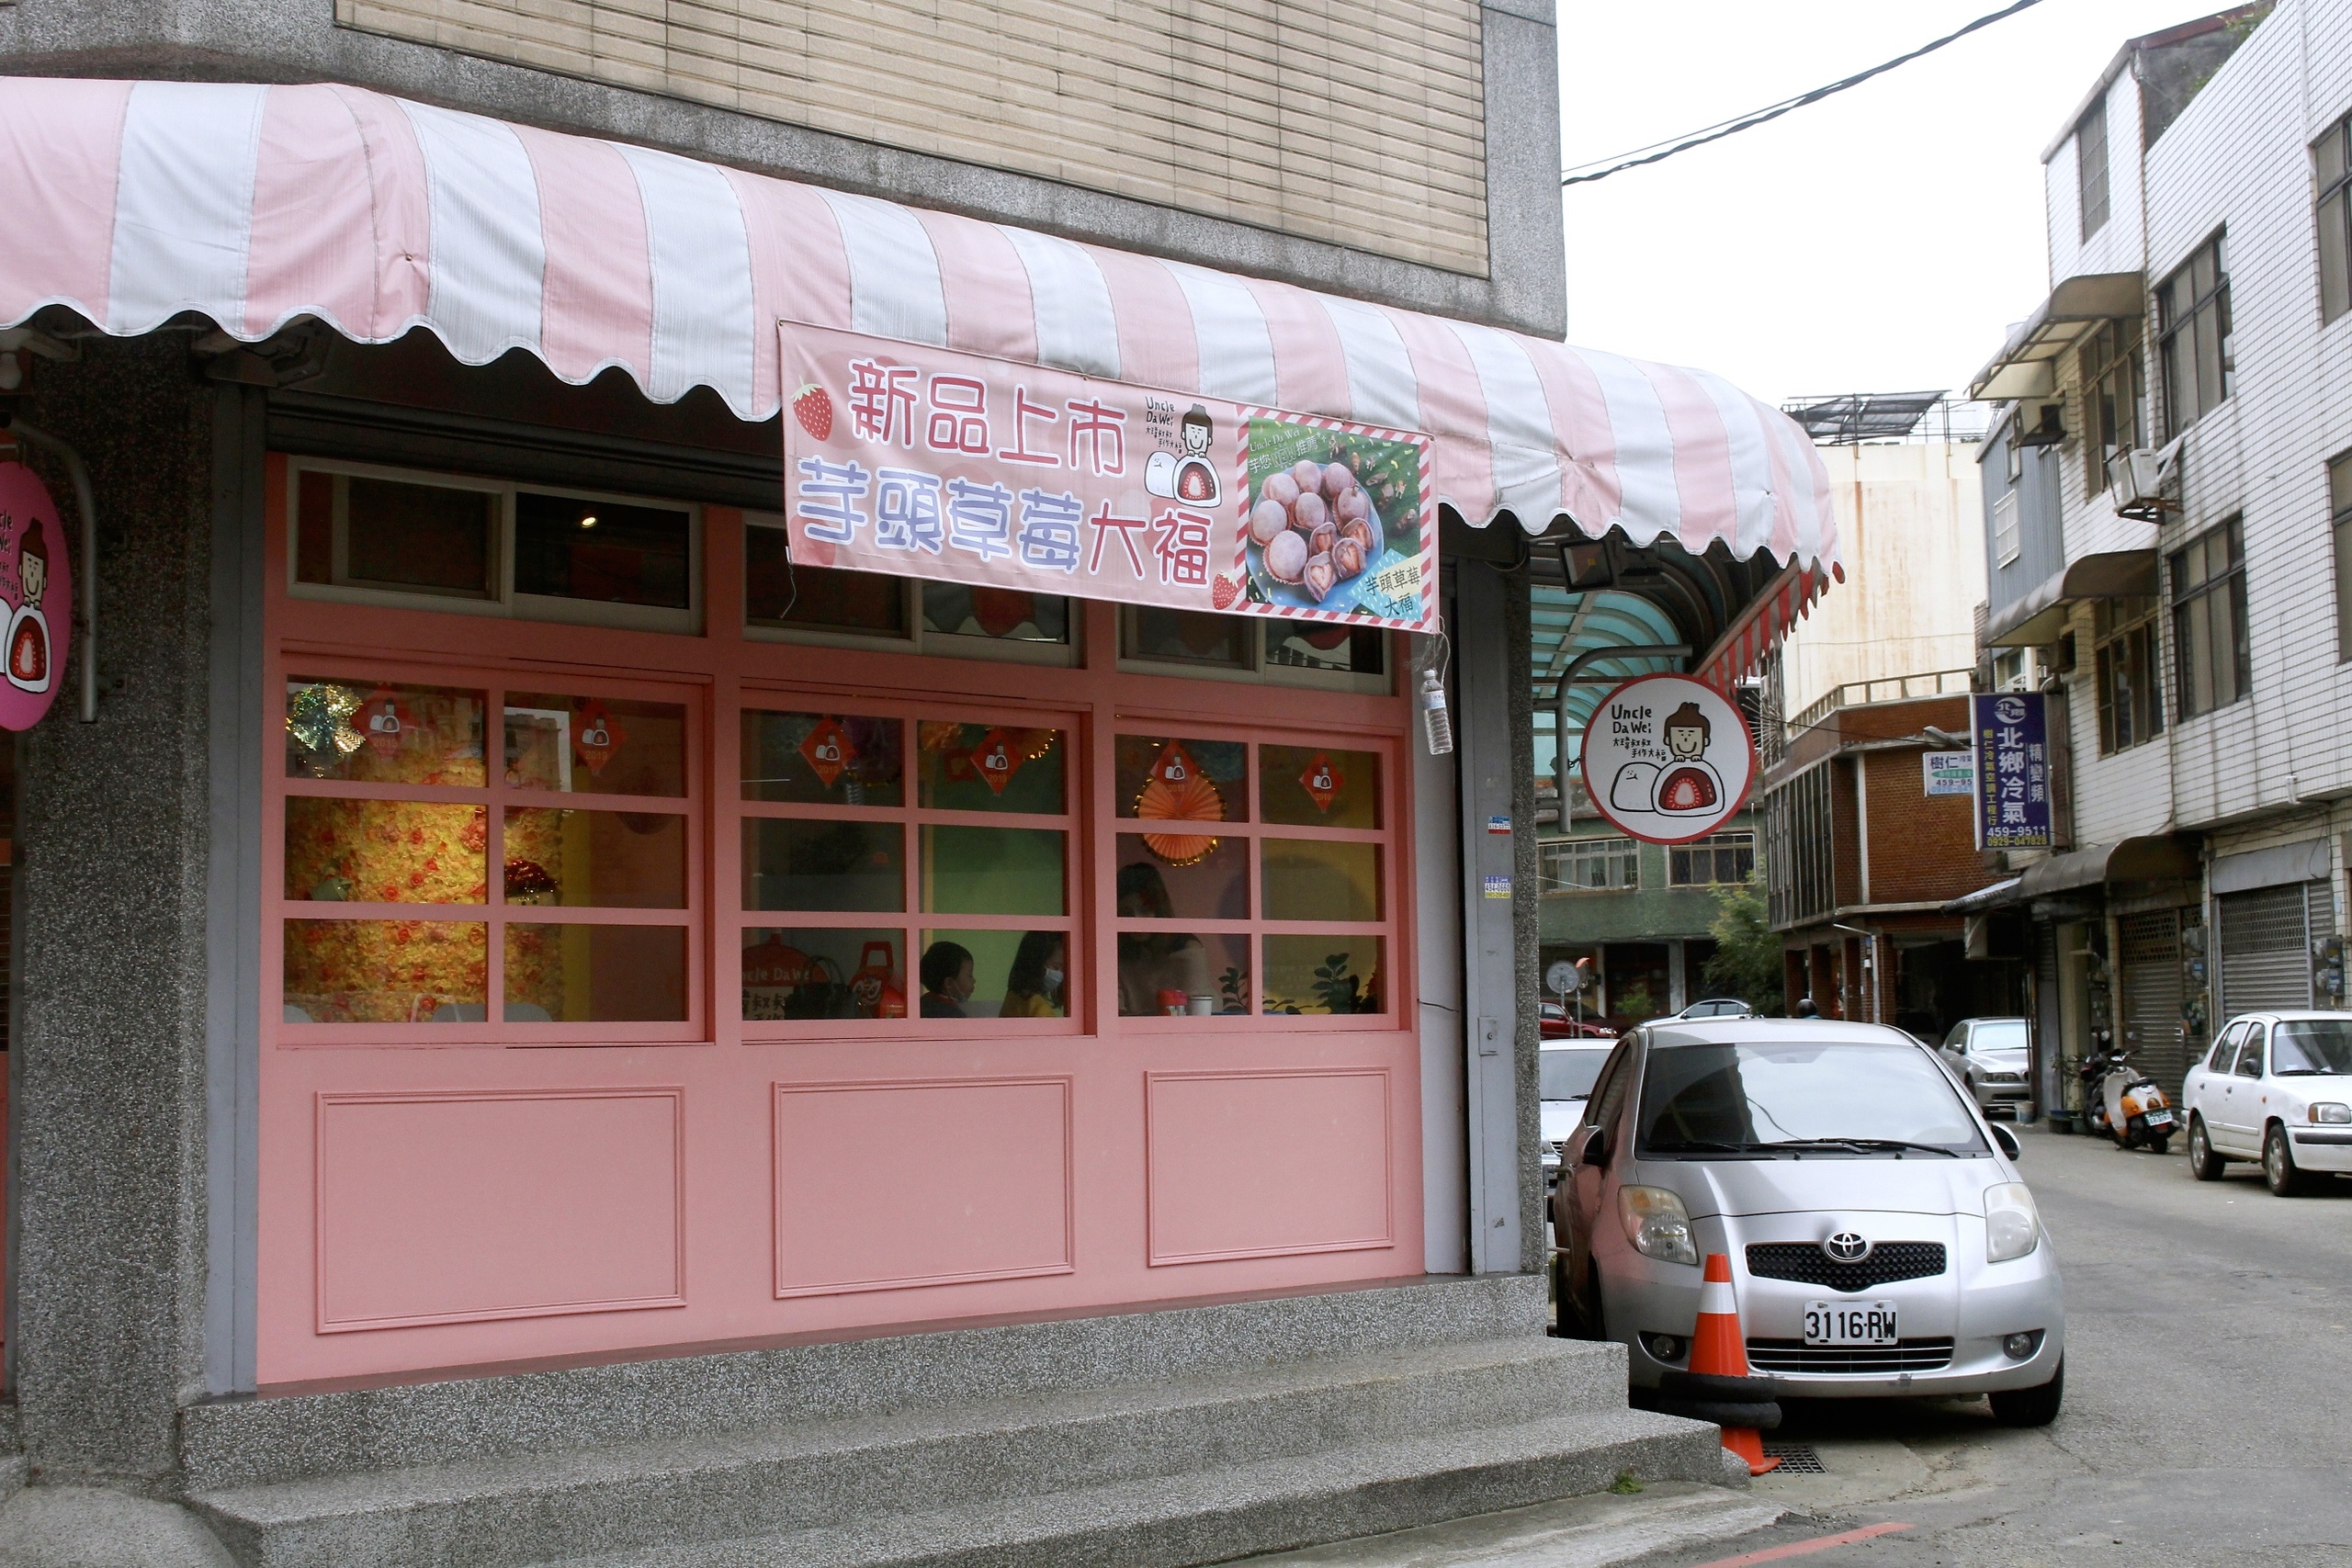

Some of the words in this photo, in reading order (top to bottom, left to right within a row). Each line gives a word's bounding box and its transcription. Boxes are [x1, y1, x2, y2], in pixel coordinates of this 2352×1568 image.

[1145, 396, 1175, 412] Uncle
[849, 359, 1127, 477] 新品上市
[1250, 438, 1271, 452] Uncle
[797, 458, 1213, 588] 芋頭草莓大福
[1365, 566, 1420, 596] 芋頭草莓
[1385, 592, 1414, 618] 大福
[1611, 704, 1652, 720] Uncle
[1631, 749, 1667, 761] 手作大福
[1997, 728, 2027, 824] 北鄉冷氣
[1986, 826, 2046, 837] 459-9511
